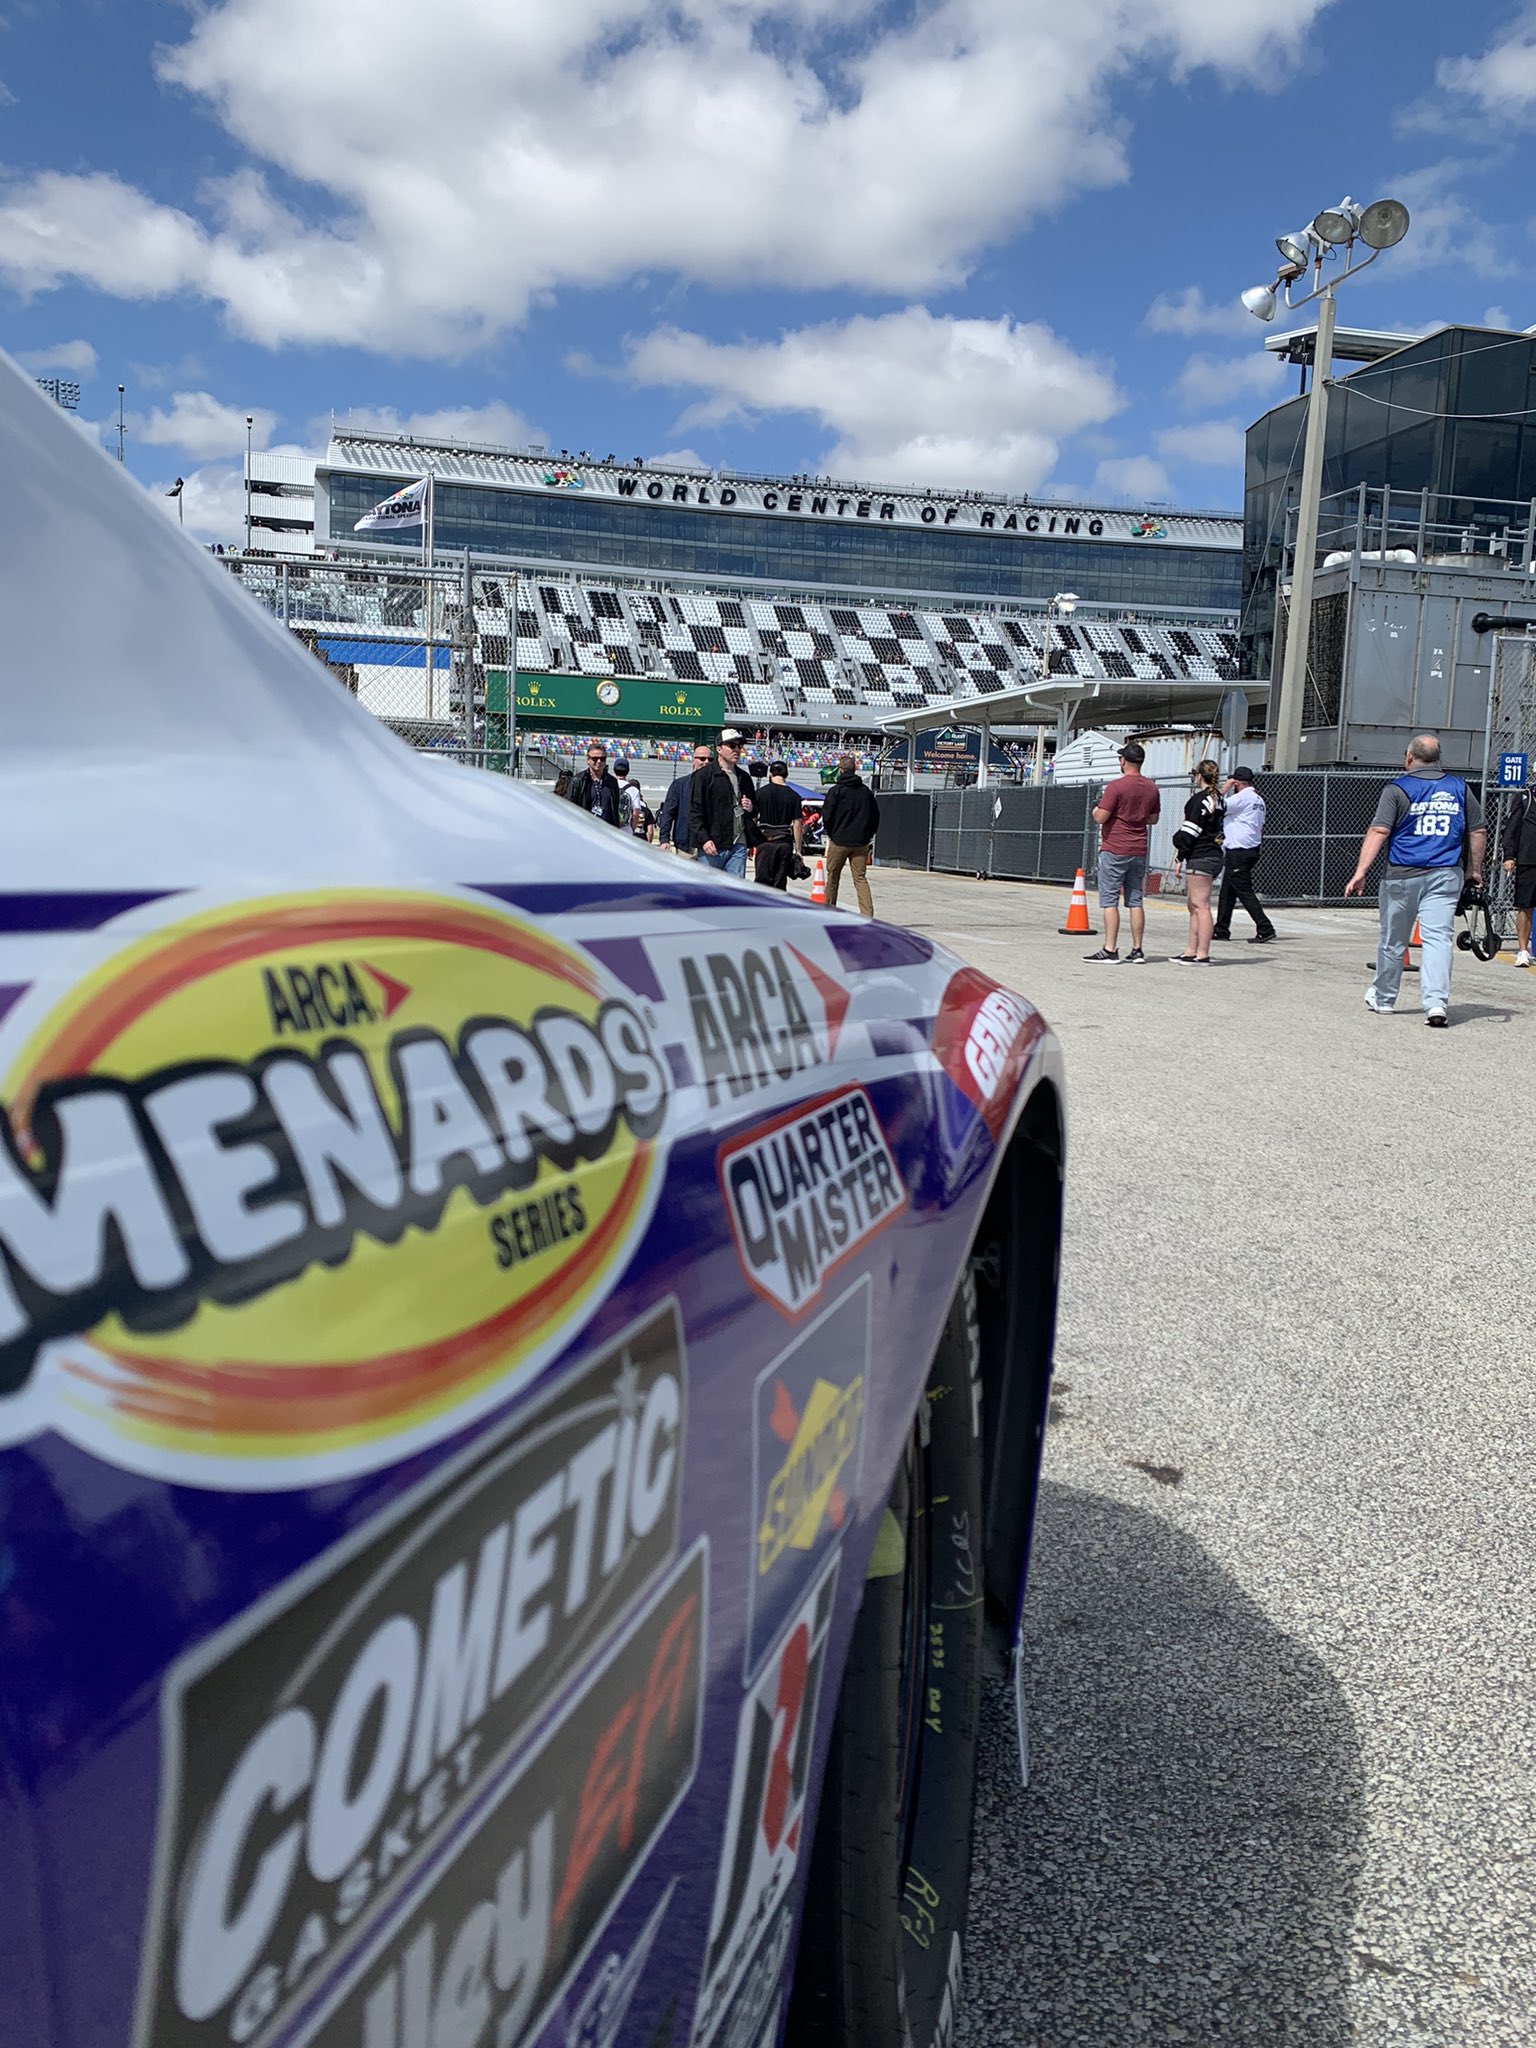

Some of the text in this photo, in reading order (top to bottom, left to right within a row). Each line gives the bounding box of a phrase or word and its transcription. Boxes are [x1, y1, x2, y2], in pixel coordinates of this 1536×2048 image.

[618, 478, 1103, 536] WORLD CENTER OF RACING
[659, 705, 702, 717] ROLEX
[923, 750, 977, 760] Welcome home.
[1504, 765, 1522, 781] 511
[1505, 756, 1523, 764] GATE
[1413, 815, 1451, 836] 183
[262, 958, 378, 1035] ARCA
[680, 944, 823, 1109] ARCA
[728, 1092, 879, 1270] QUARTER
[488, 1184, 589, 1272] SERIES
[776, 1147, 901, 1300] MASTER
[175, 1372, 680, 2022] COMETIC
[227, 1732, 484, 2044] GASKET
